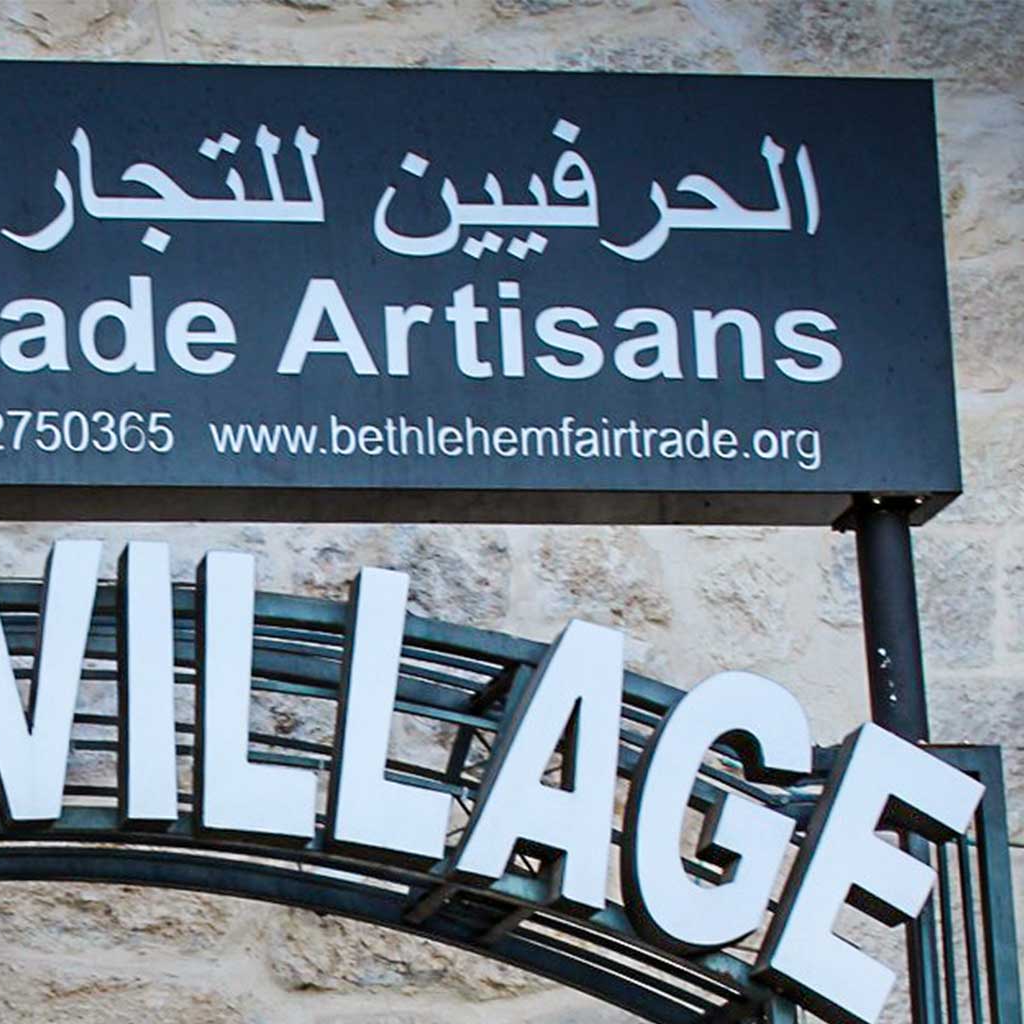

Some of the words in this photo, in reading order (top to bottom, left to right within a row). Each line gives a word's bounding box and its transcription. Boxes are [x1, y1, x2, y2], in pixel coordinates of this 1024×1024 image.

[374, 117, 820, 261] الحرفيين
[276, 278, 844, 382] Artisans
[208, 413, 822, 471] www.bethlehemfairtrade.org
